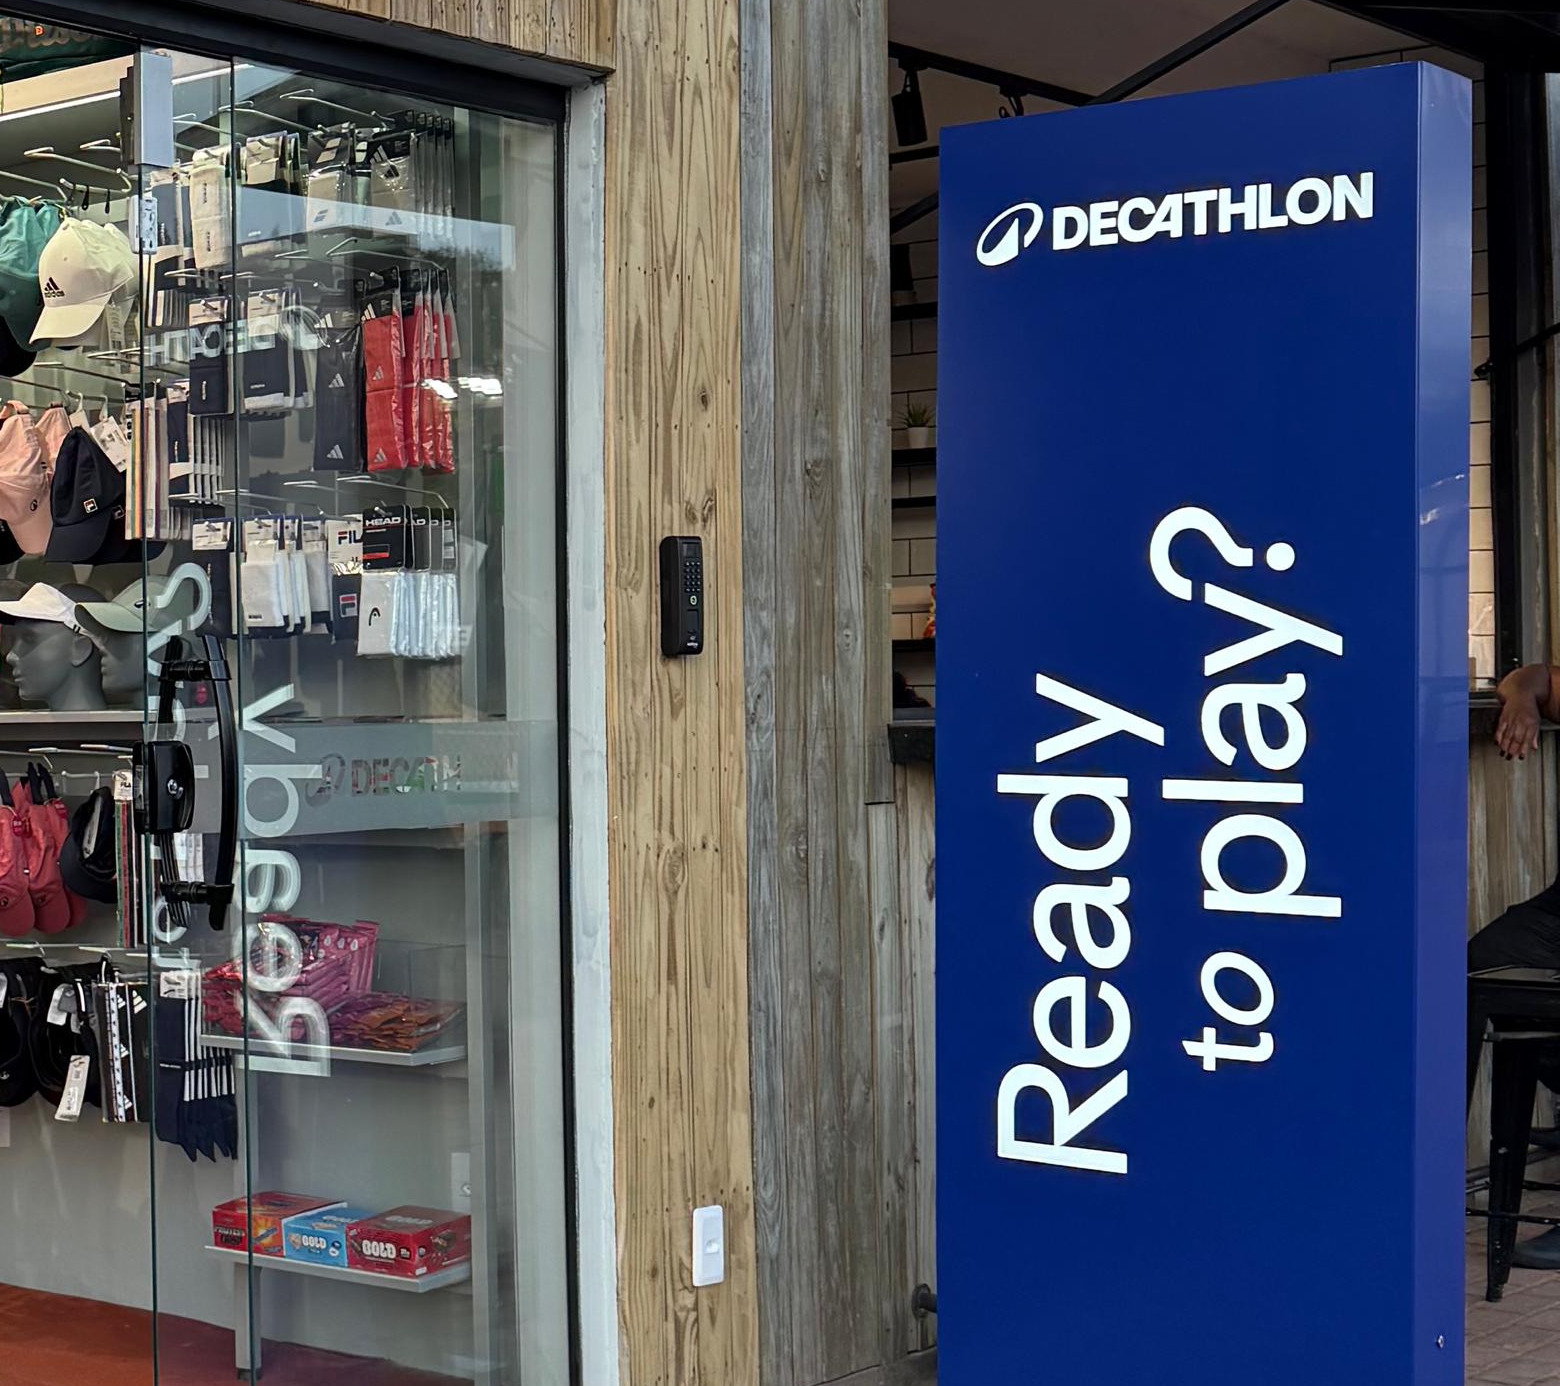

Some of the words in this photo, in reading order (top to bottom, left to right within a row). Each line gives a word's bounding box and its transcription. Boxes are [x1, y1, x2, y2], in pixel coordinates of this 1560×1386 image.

[1052, 171, 1374, 251] DECATHLON
[337, 530, 363, 545] FIL
[365, 516, 402, 527] HEAD
[1149, 505, 1343, 918] play?
[997, 673, 1164, 1174] Ready
[1182, 950, 1274, 1071] to
